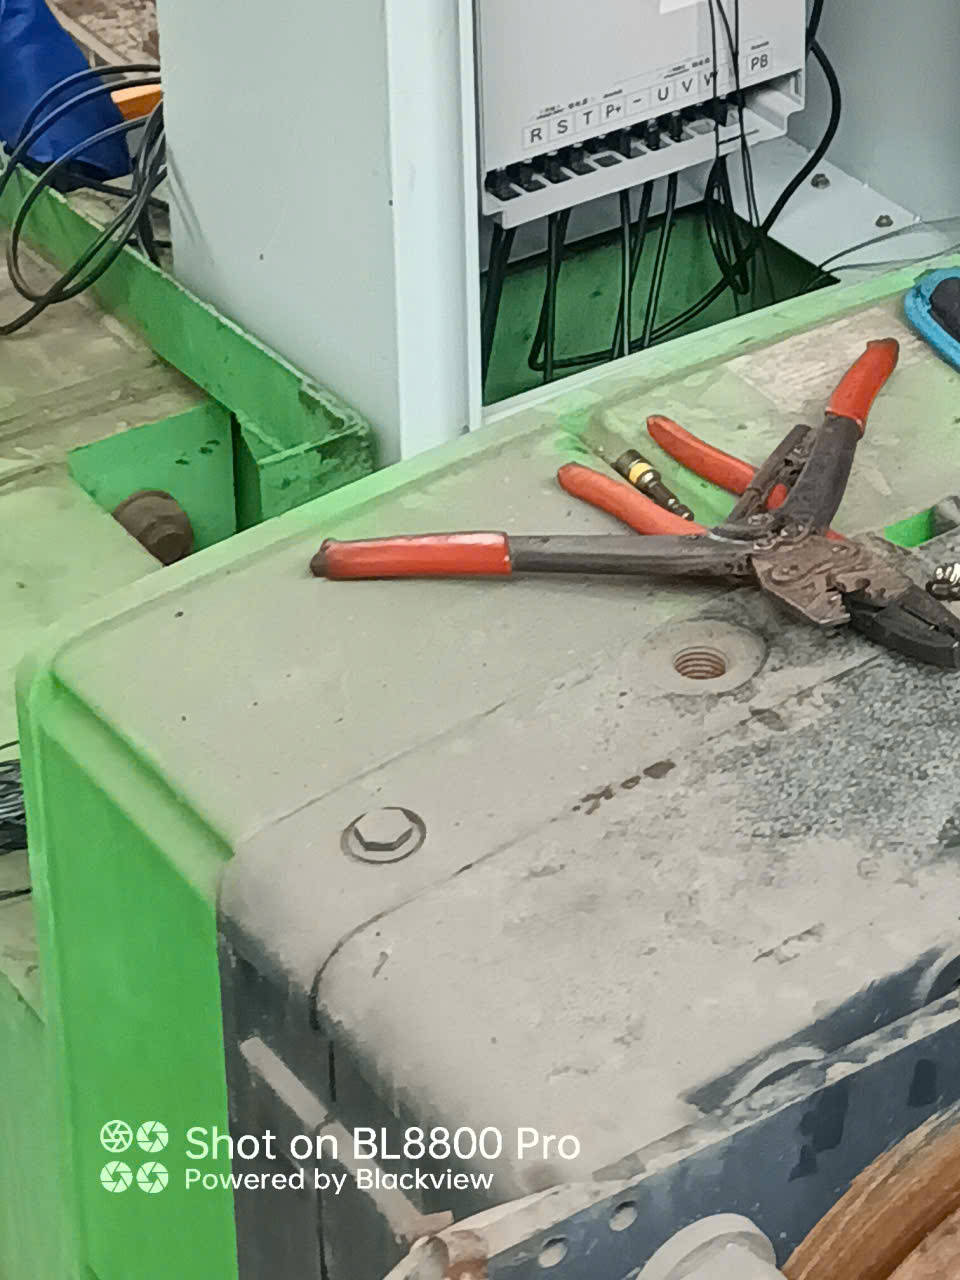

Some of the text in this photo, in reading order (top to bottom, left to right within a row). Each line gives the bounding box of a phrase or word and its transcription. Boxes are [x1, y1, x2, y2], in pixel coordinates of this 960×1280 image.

[530, 127, 543, 143] R
[557, 120, 568, 134] S
[583, 111, 593, 125] T
[657, 86, 669, 101] U
[682, 78, 693, 93] V
[750, 54, 768, 70] PB
